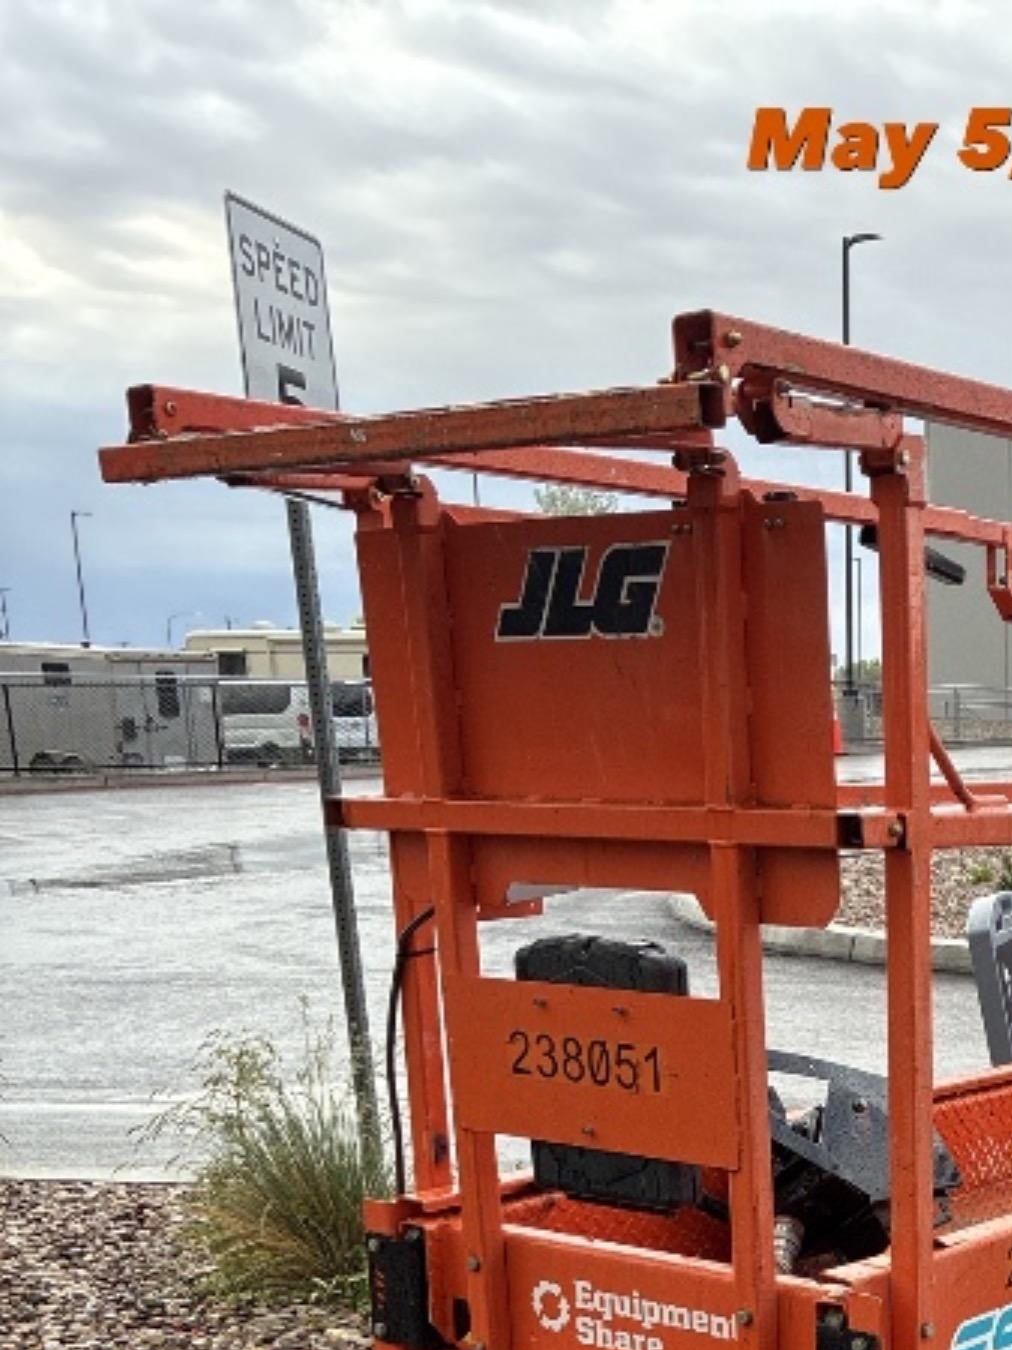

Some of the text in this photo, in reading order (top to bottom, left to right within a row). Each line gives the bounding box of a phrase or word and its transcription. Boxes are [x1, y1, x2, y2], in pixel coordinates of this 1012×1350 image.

[239, 232, 319, 307] SPEED
[254, 297, 315, 360] LIMIT
[496, 540, 672, 639] JLG
[506, 1029, 661, 1093] 238051
